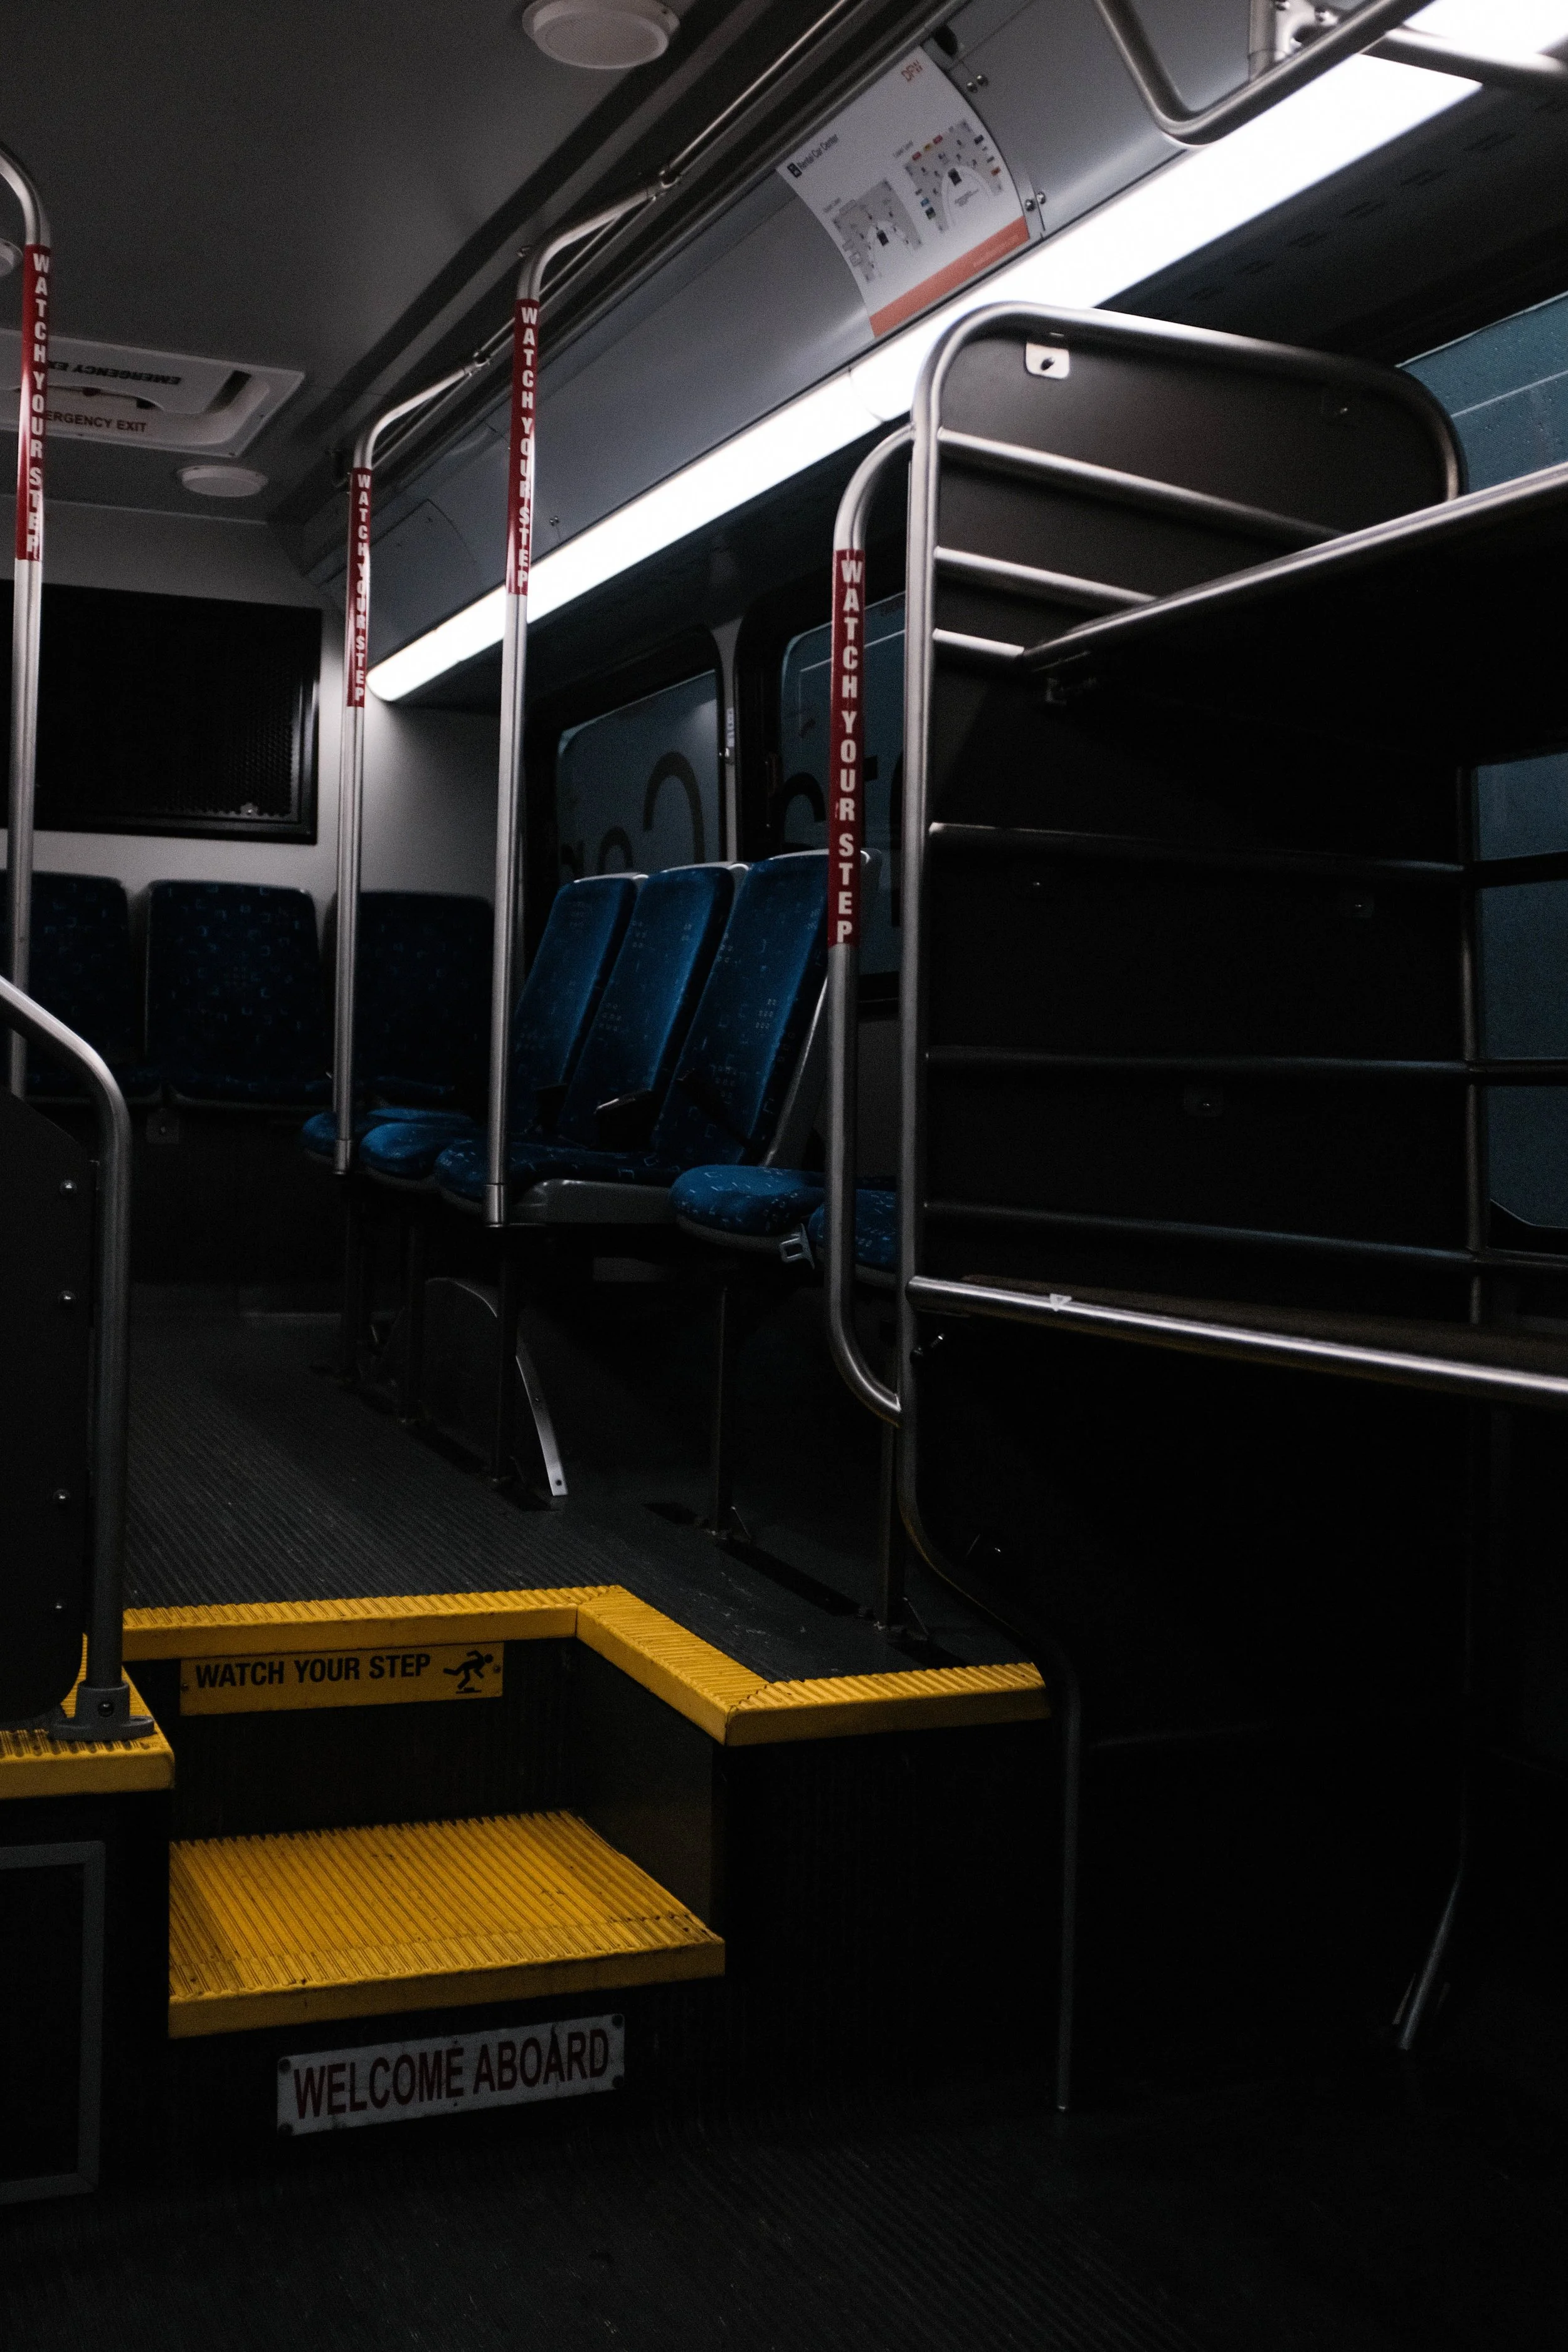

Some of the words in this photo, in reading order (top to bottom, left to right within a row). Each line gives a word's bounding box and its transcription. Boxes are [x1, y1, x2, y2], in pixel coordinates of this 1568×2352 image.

[33, 253, 50, 363] WATCH
[521, 306, 538, 410] WATCH
[29, 371, 46, 458] YOUR
[46, 410, 113, 428] ERGENCY
[116, 420, 147, 432] EXIT
[520, 417, 533, 500] YOUR
[26, 467, 41, 552] STEP
[357, 474, 371, 557] WATCH
[517, 507, 530, 588] STEP
[356, 563, 368, 629] YOUR
[840, 559, 864, 698] WATCH
[354, 635, 366, 701] STEP
[839, 711, 858, 822] YOUR
[836, 832, 854, 943] STEP
[196, 1660, 284, 1688] WATCH
[294, 1657, 360, 1683] YOUR
[369, 1653, 431, 1679] STEP
[294, 2047, 465, 2119] WELCOME
[473, 2028, 609, 2094] ABOARD
